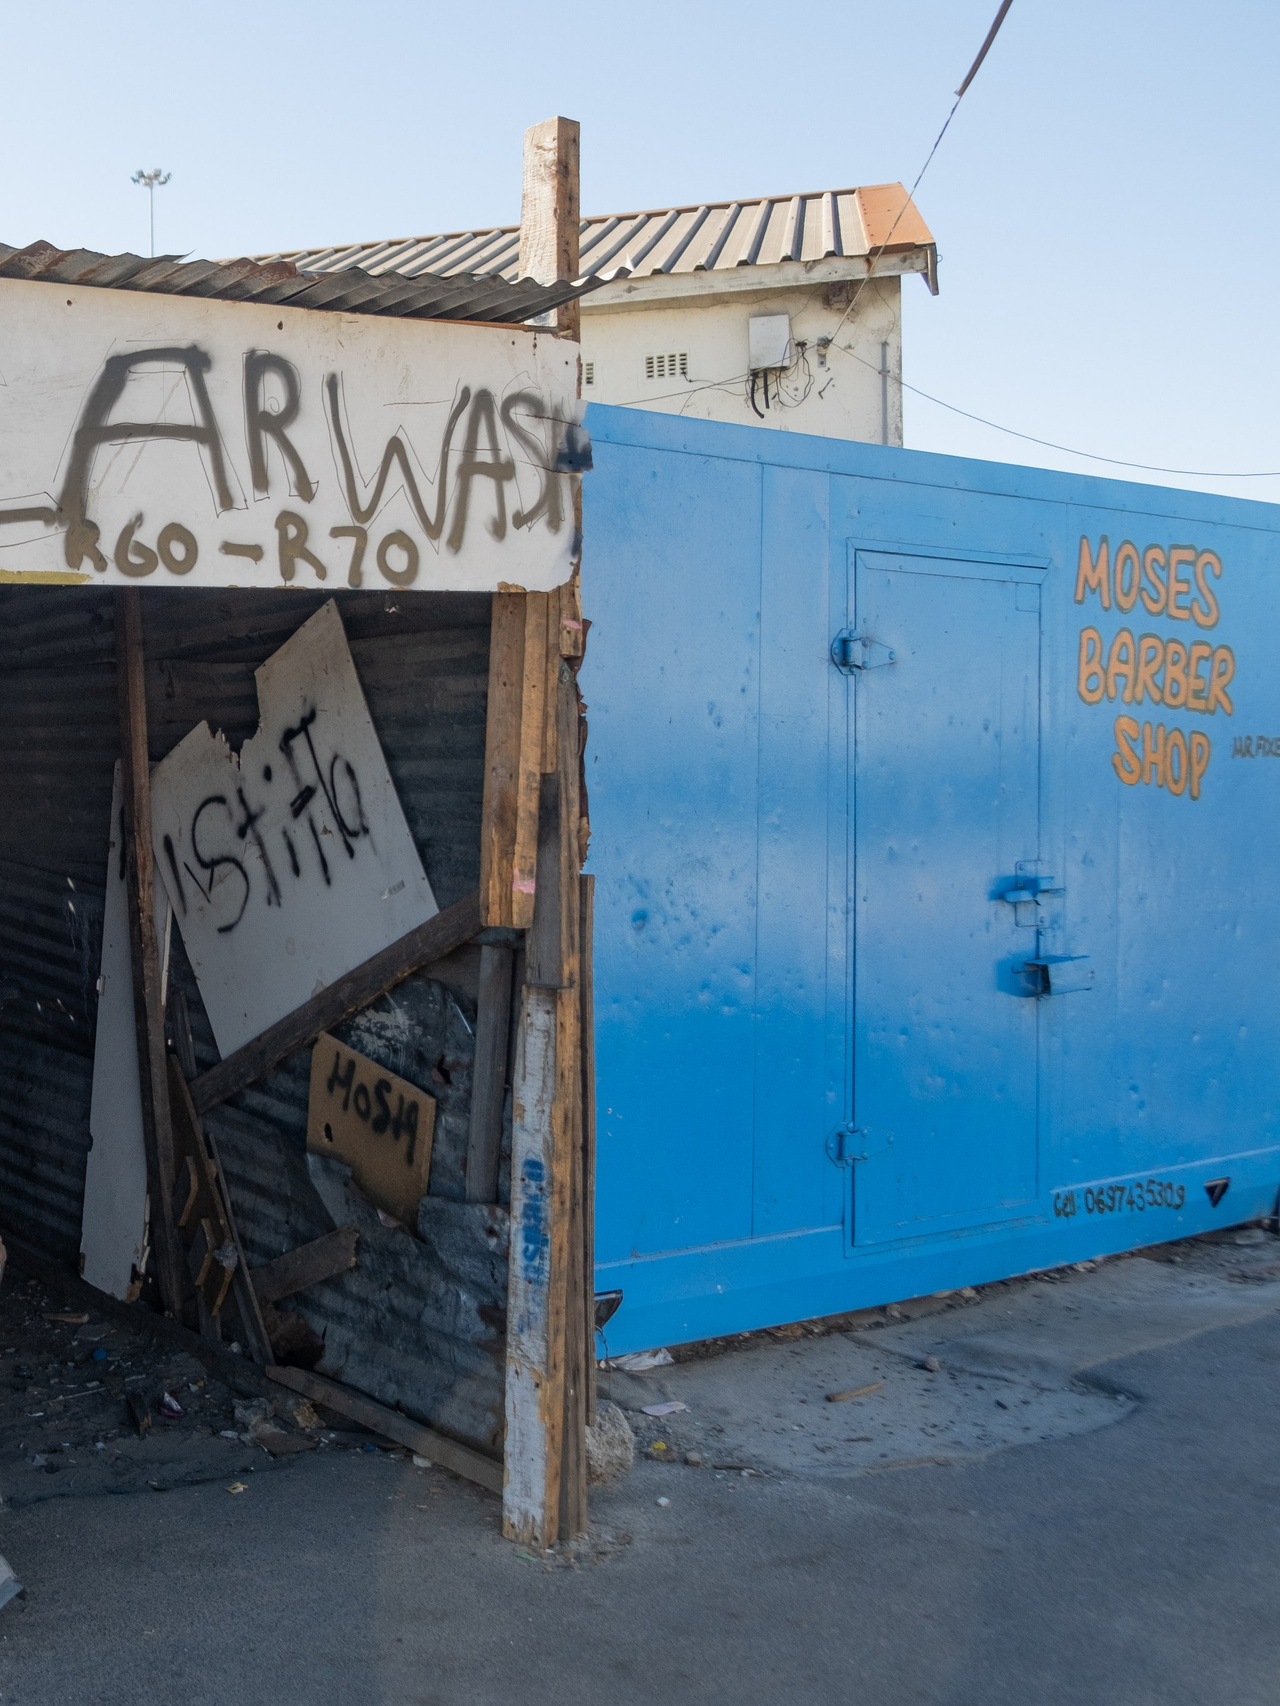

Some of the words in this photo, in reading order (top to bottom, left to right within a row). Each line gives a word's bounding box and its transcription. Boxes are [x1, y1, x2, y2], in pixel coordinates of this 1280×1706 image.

[1074, 534, 1222, 630] MOSES
[1077, 625, 1235, 716] BARBER
[1111, 714, 1211, 801] SHOP
